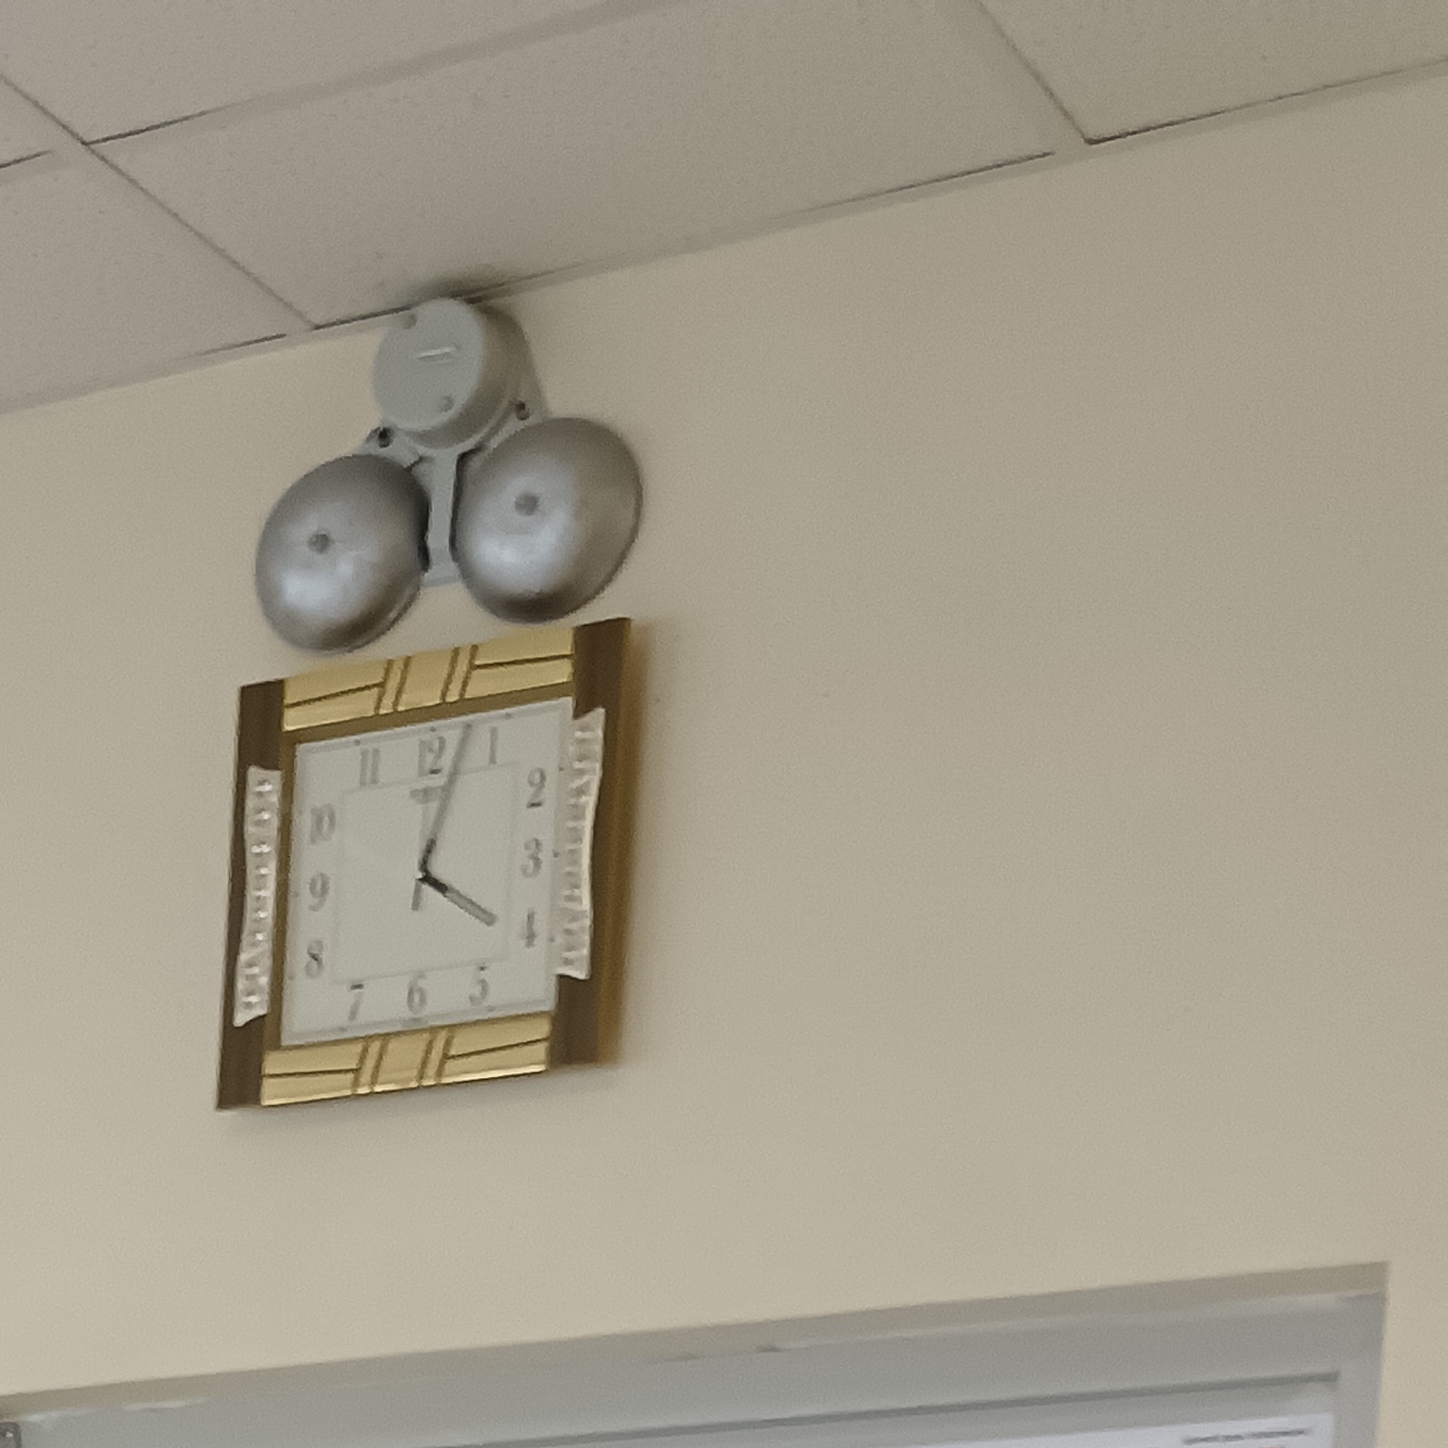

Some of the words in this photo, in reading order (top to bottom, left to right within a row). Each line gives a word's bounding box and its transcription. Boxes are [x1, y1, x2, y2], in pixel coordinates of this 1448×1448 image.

[418, 736, 445, 775] 12
[526, 767, 547, 809] 2
[521, 838, 544, 879] 3
[307, 872, 330, 912] 9
[407, 976, 428, 1014] 6
